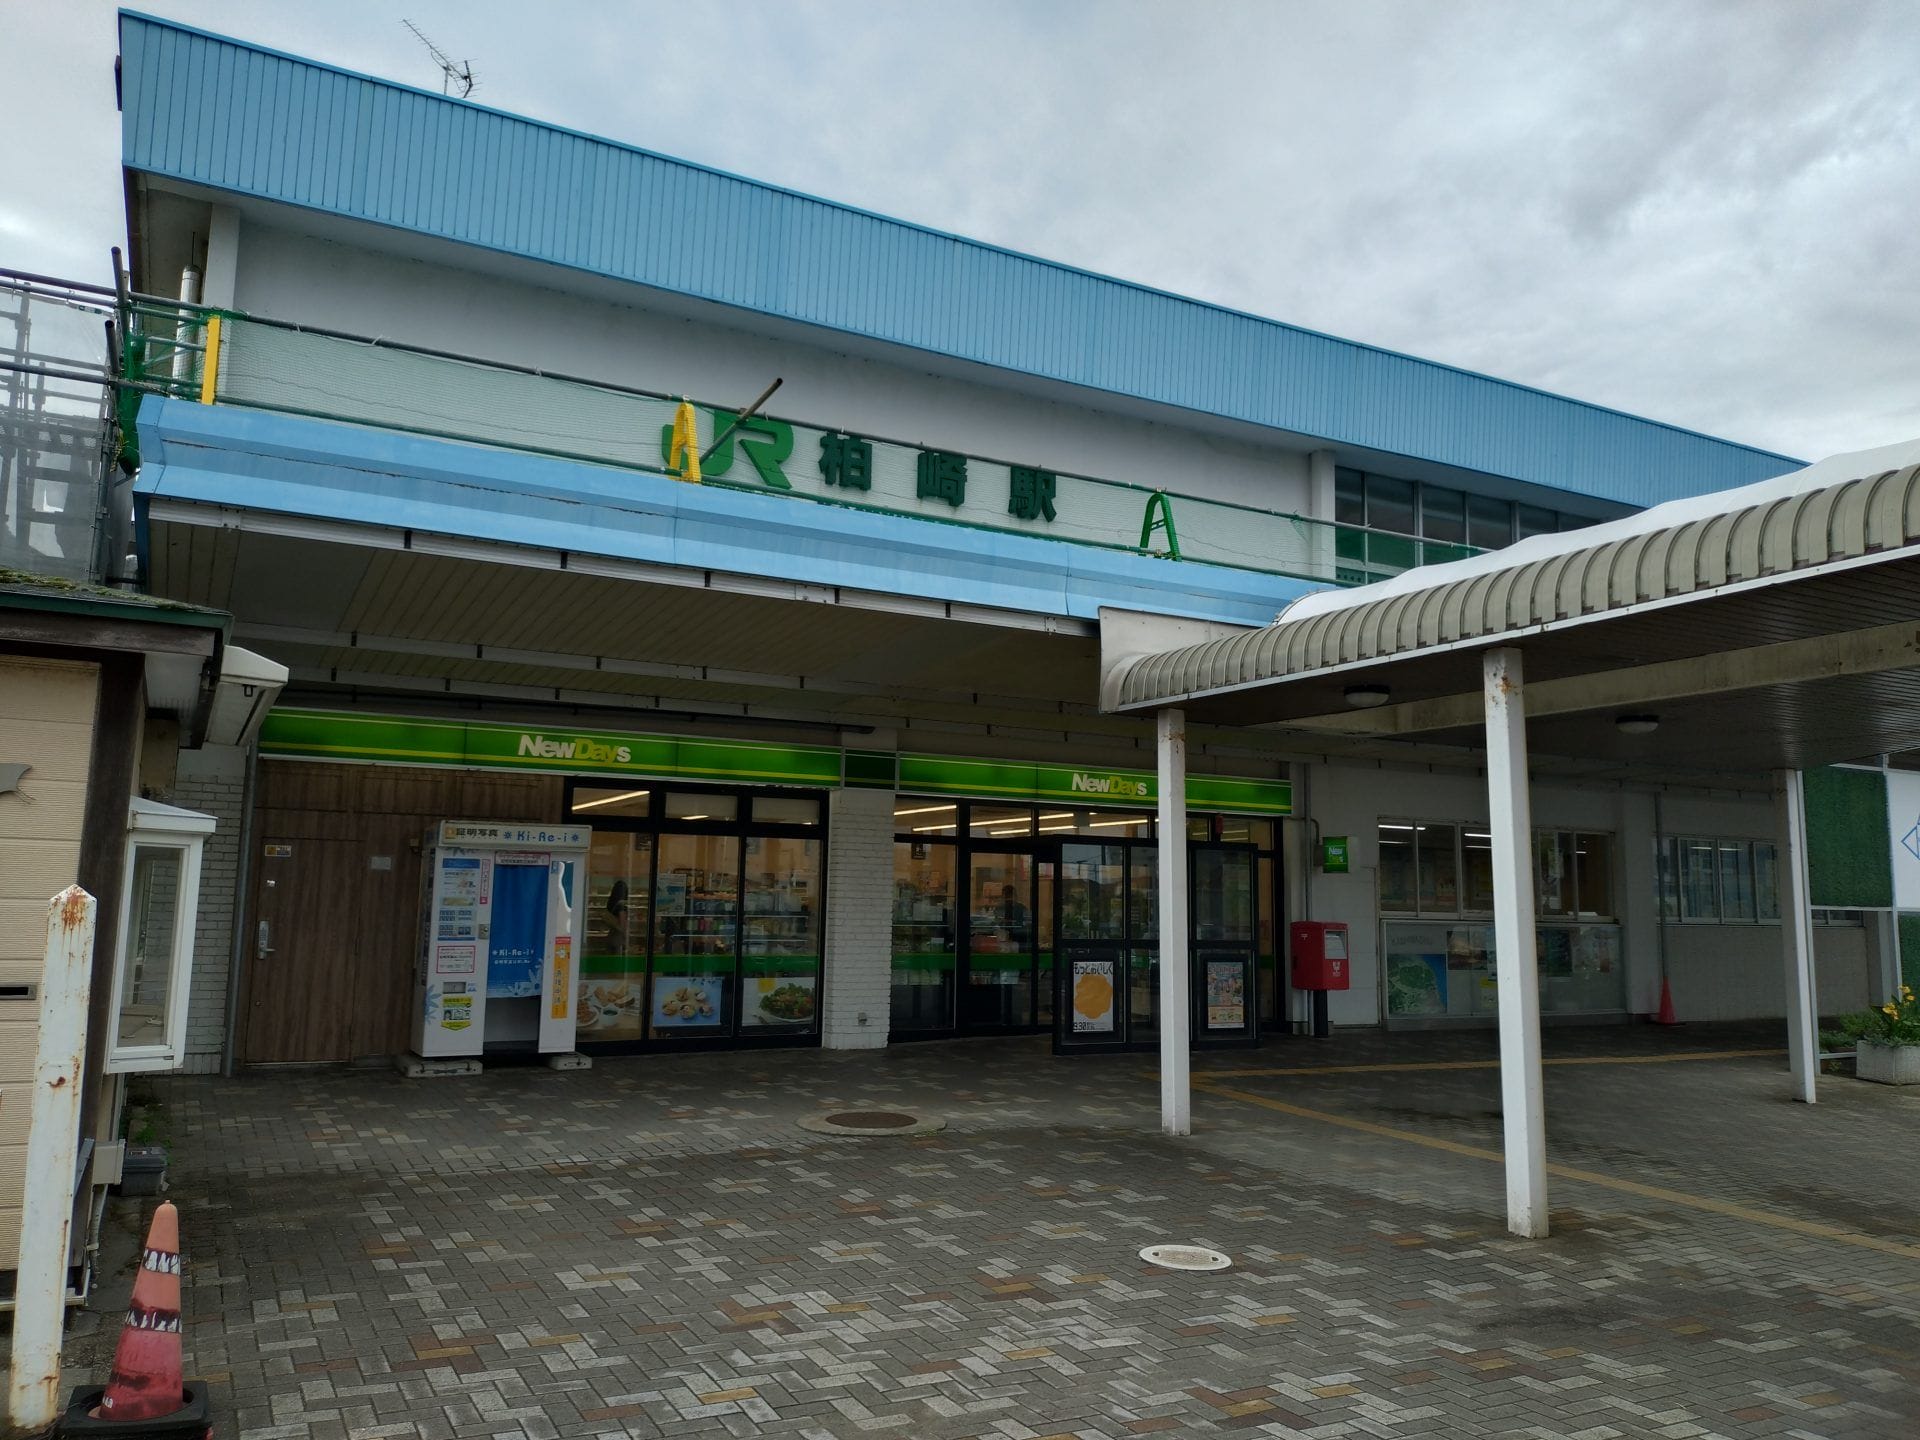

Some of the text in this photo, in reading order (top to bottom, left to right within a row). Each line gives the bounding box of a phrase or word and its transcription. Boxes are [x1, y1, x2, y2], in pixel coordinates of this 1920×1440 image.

[661, 408, 1058, 523] JR 柏崎駅
[518, 734, 631, 765] NewDays
[1070, 772, 1148, 800] NewDays
[456, 826, 567, 843] 証明写真 Ki-Re-i
